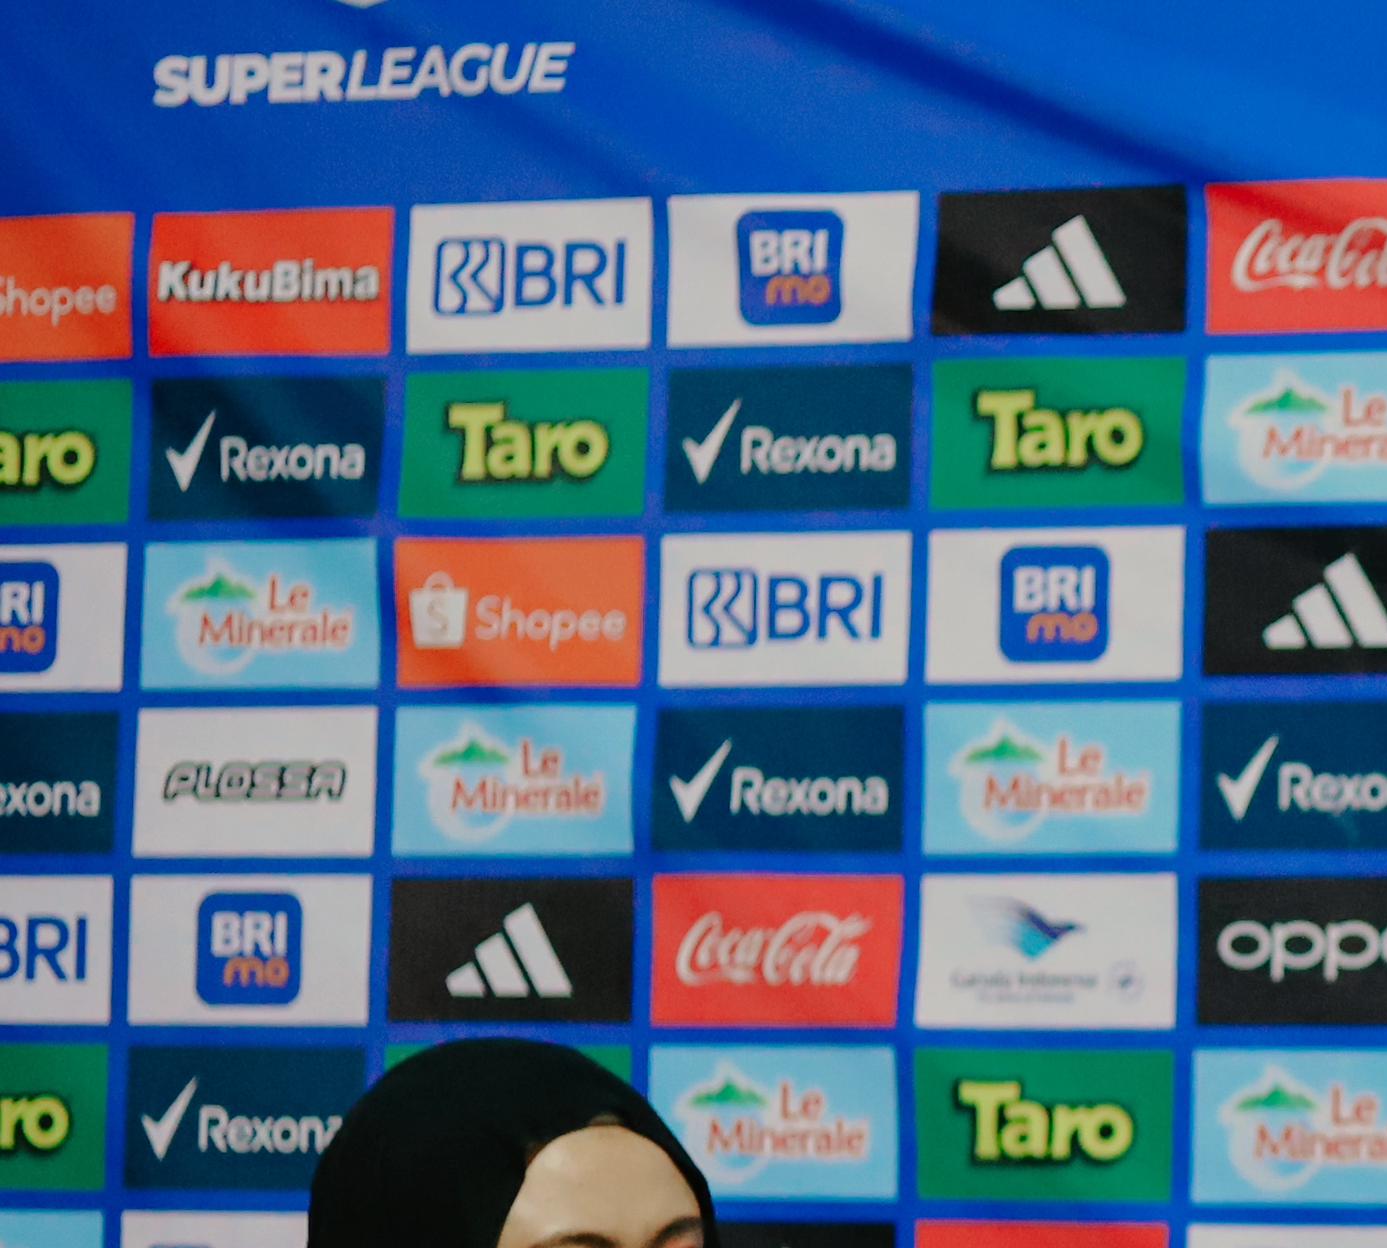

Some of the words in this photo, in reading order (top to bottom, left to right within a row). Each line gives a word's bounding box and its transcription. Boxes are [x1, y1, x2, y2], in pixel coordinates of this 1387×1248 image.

[515, 240, 626, 308] BRI
[750, 229, 827, 277] BRI
[156, 257, 380, 304] KukuBima
[974, 389, 1146, 470] Taro
[1340, 388, 1387, 426] Le
[220, 435, 366, 484] Rexona
[449, 401, 609, 482] Taro
[741, 425, 896, 474] Rexona
[269, 573, 309, 613] Le
[765, 573, 883, 641] BRI
[1013, 565, 1095, 614] BRI
[200, 610, 350, 649] Minerale
[475, 597, 626, 650] Shopee
[519, 739, 560, 777] Le
[1057, 736, 1105, 776] Le
[450, 774, 602, 814] Minerale
[730, 769, 889, 816] Rexona
[983, 770, 1149, 814] Minerale
[211, 912, 287, 956] BRI
[780, 1083, 821, 1122] Le
[956, 1082, 1133, 1162] Taro
[1330, 1086, 1378, 1125] Le
[706, 1117, 869, 1159] Minerale
